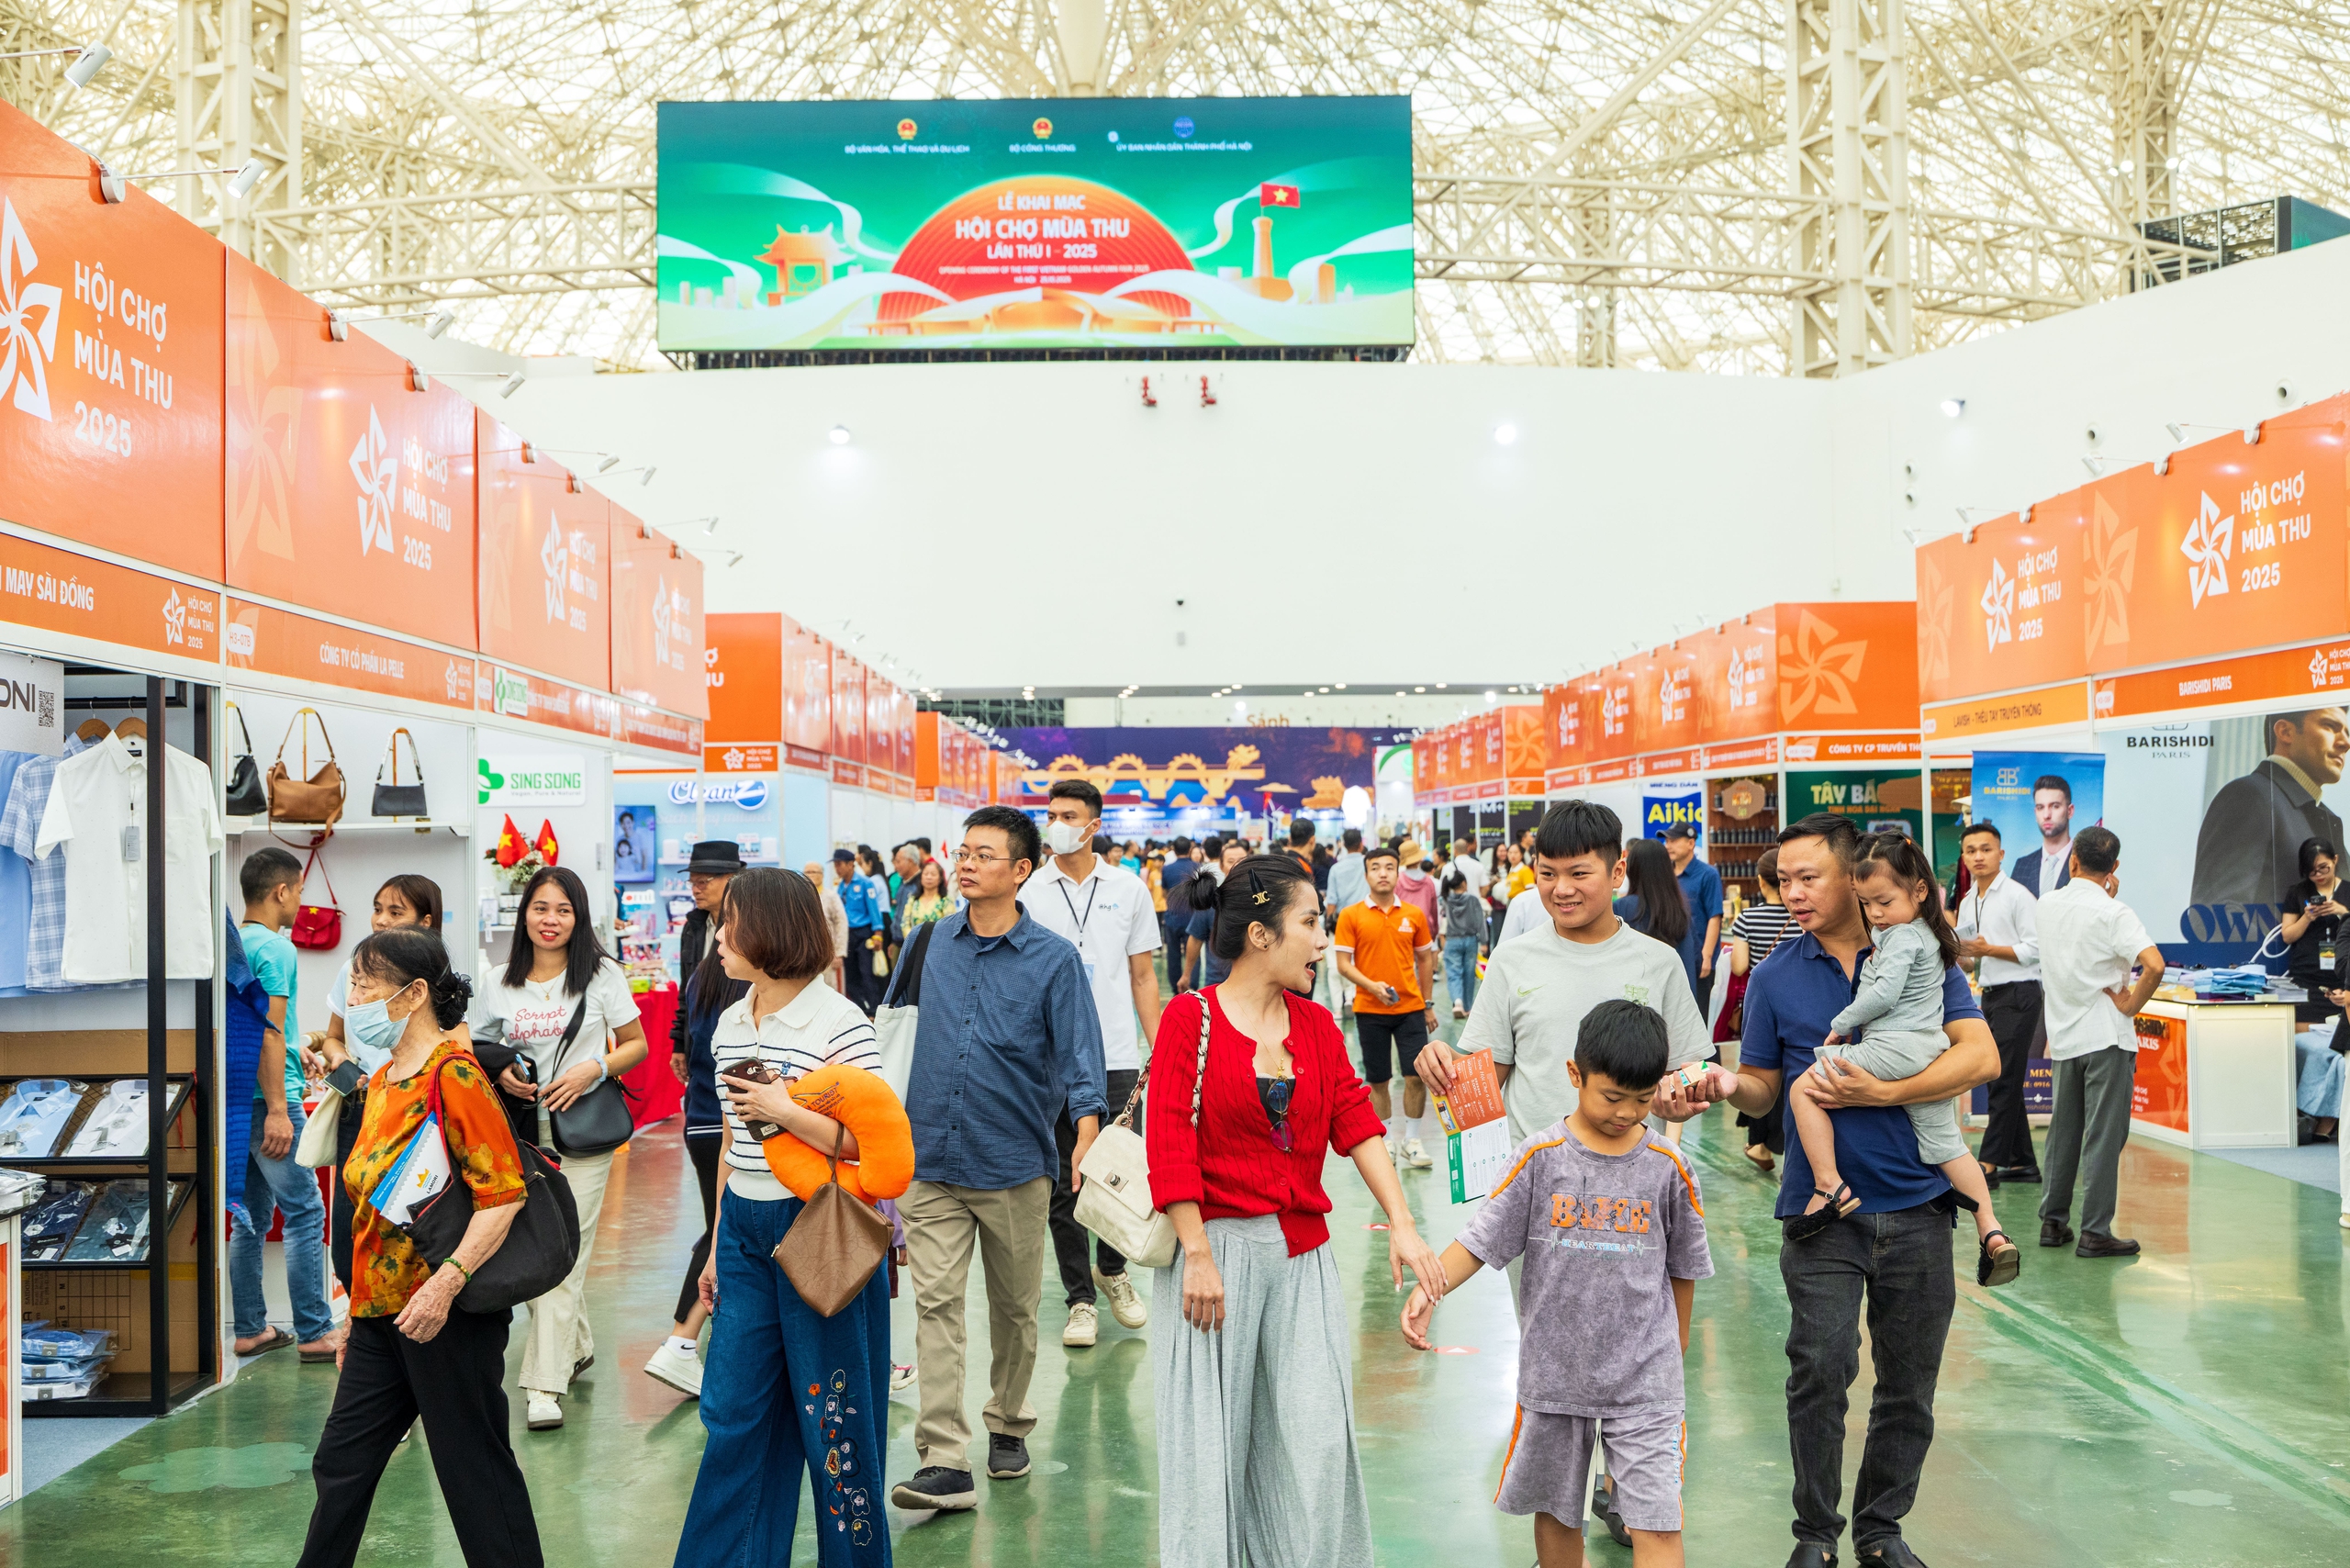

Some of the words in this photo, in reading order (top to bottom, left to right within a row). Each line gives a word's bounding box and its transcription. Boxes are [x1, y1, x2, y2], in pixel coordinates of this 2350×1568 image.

[998, 191, 1013, 210] LỄ
[1017, 196, 1050, 210] KHAI
[1054, 195, 1086, 211] MẠC
[956, 216, 990, 241] HỘI
[995, 218, 1038, 241] CHỢ
[1043, 216, 1087, 239] MÙA
[1091, 218, 1130, 238] THU
[1063, 243, 1098, 258] 2025
[74, 260, 115, 323] HỘI
[120, 288, 166, 353] CHỢ
[74, 329, 125, 389] MÙA
[130, 356, 173, 409] THU
[74, 400, 131, 457] 2025
[403, 435, 422, 479] HỘI
[425, 450, 448, 493] CHỢ
[2241, 480, 2267, 518] HỘI
[2270, 470, 2305, 506] CHỢ
[403, 482, 428, 522] MÙA
[430, 498, 452, 532] THU
[2242, 520, 2276, 554] MÙA
[2278, 513, 2311, 544] THU
[403, 534, 431, 571] 2025
[2018, 552, 2034, 582] HỘI
[2036, 544, 2058, 575] CHỢ
[2242, 562, 2280, 593] 2025
[6, 566, 34, 598] MAY
[37, 571, 56, 602] SÀI
[60, 575, 94, 611] ĐỒNG
[2019, 583, 2040, 610] MÙA
[2041, 580, 2062, 604] THU
[187, 595, 198, 616] HỘI
[199, 600, 213, 618] CHỢ
[187, 613, 201, 630] MÙA
[203, 620, 214, 633] THU
[570, 606, 587, 633] 2025
[2019, 617, 2043, 641] 2025
[187, 635, 203, 649] 2025
[319, 641, 340, 666] CÔNG
[341, 648, 350, 667] TY
[351, 644, 360, 670] CỔ
[361, 649, 378, 674] PHẦN
[379, 656, 387, 676] LA
[2329, 648, 2338, 663] HỘI
[2330, 661, 2341, 672] MÙA
[2179, 678, 2210, 696] BARISHIDI
[2212, 675, 2232, 691] PARIS
[2330, 675, 2344, 685] 2025
[1953, 714, 1970, 728] LAVISH
[1829, 743, 1852, 755] CÔNG
[1853, 745, 1863, 753] TY
[1864, 744, 1874, 753] CP
[1876, 741, 1908, 753] TRUYỀN
[2127, 735, 2214, 748] BARISHIDI
[2152, 751, 2190, 759] PARIS
[511, 773, 542, 789] SING
[545, 773, 581, 789] SONG
[1984, 787, 2031, 795] BARISHIDI
[1810, 780, 1847, 804] TÂY
[515, 1005, 566, 1025] Script
[509, 1020, 567, 1046] alphabe
[2137, 1036, 2159, 1050] ARIS
[2030, 1069, 2052, 1078] MEN
[811, 1087, 838, 1107] TOURIST
[426, 1174, 439, 1194] LAMORI
[1561, 1238, 1634, 1252] HEARTBEAT
